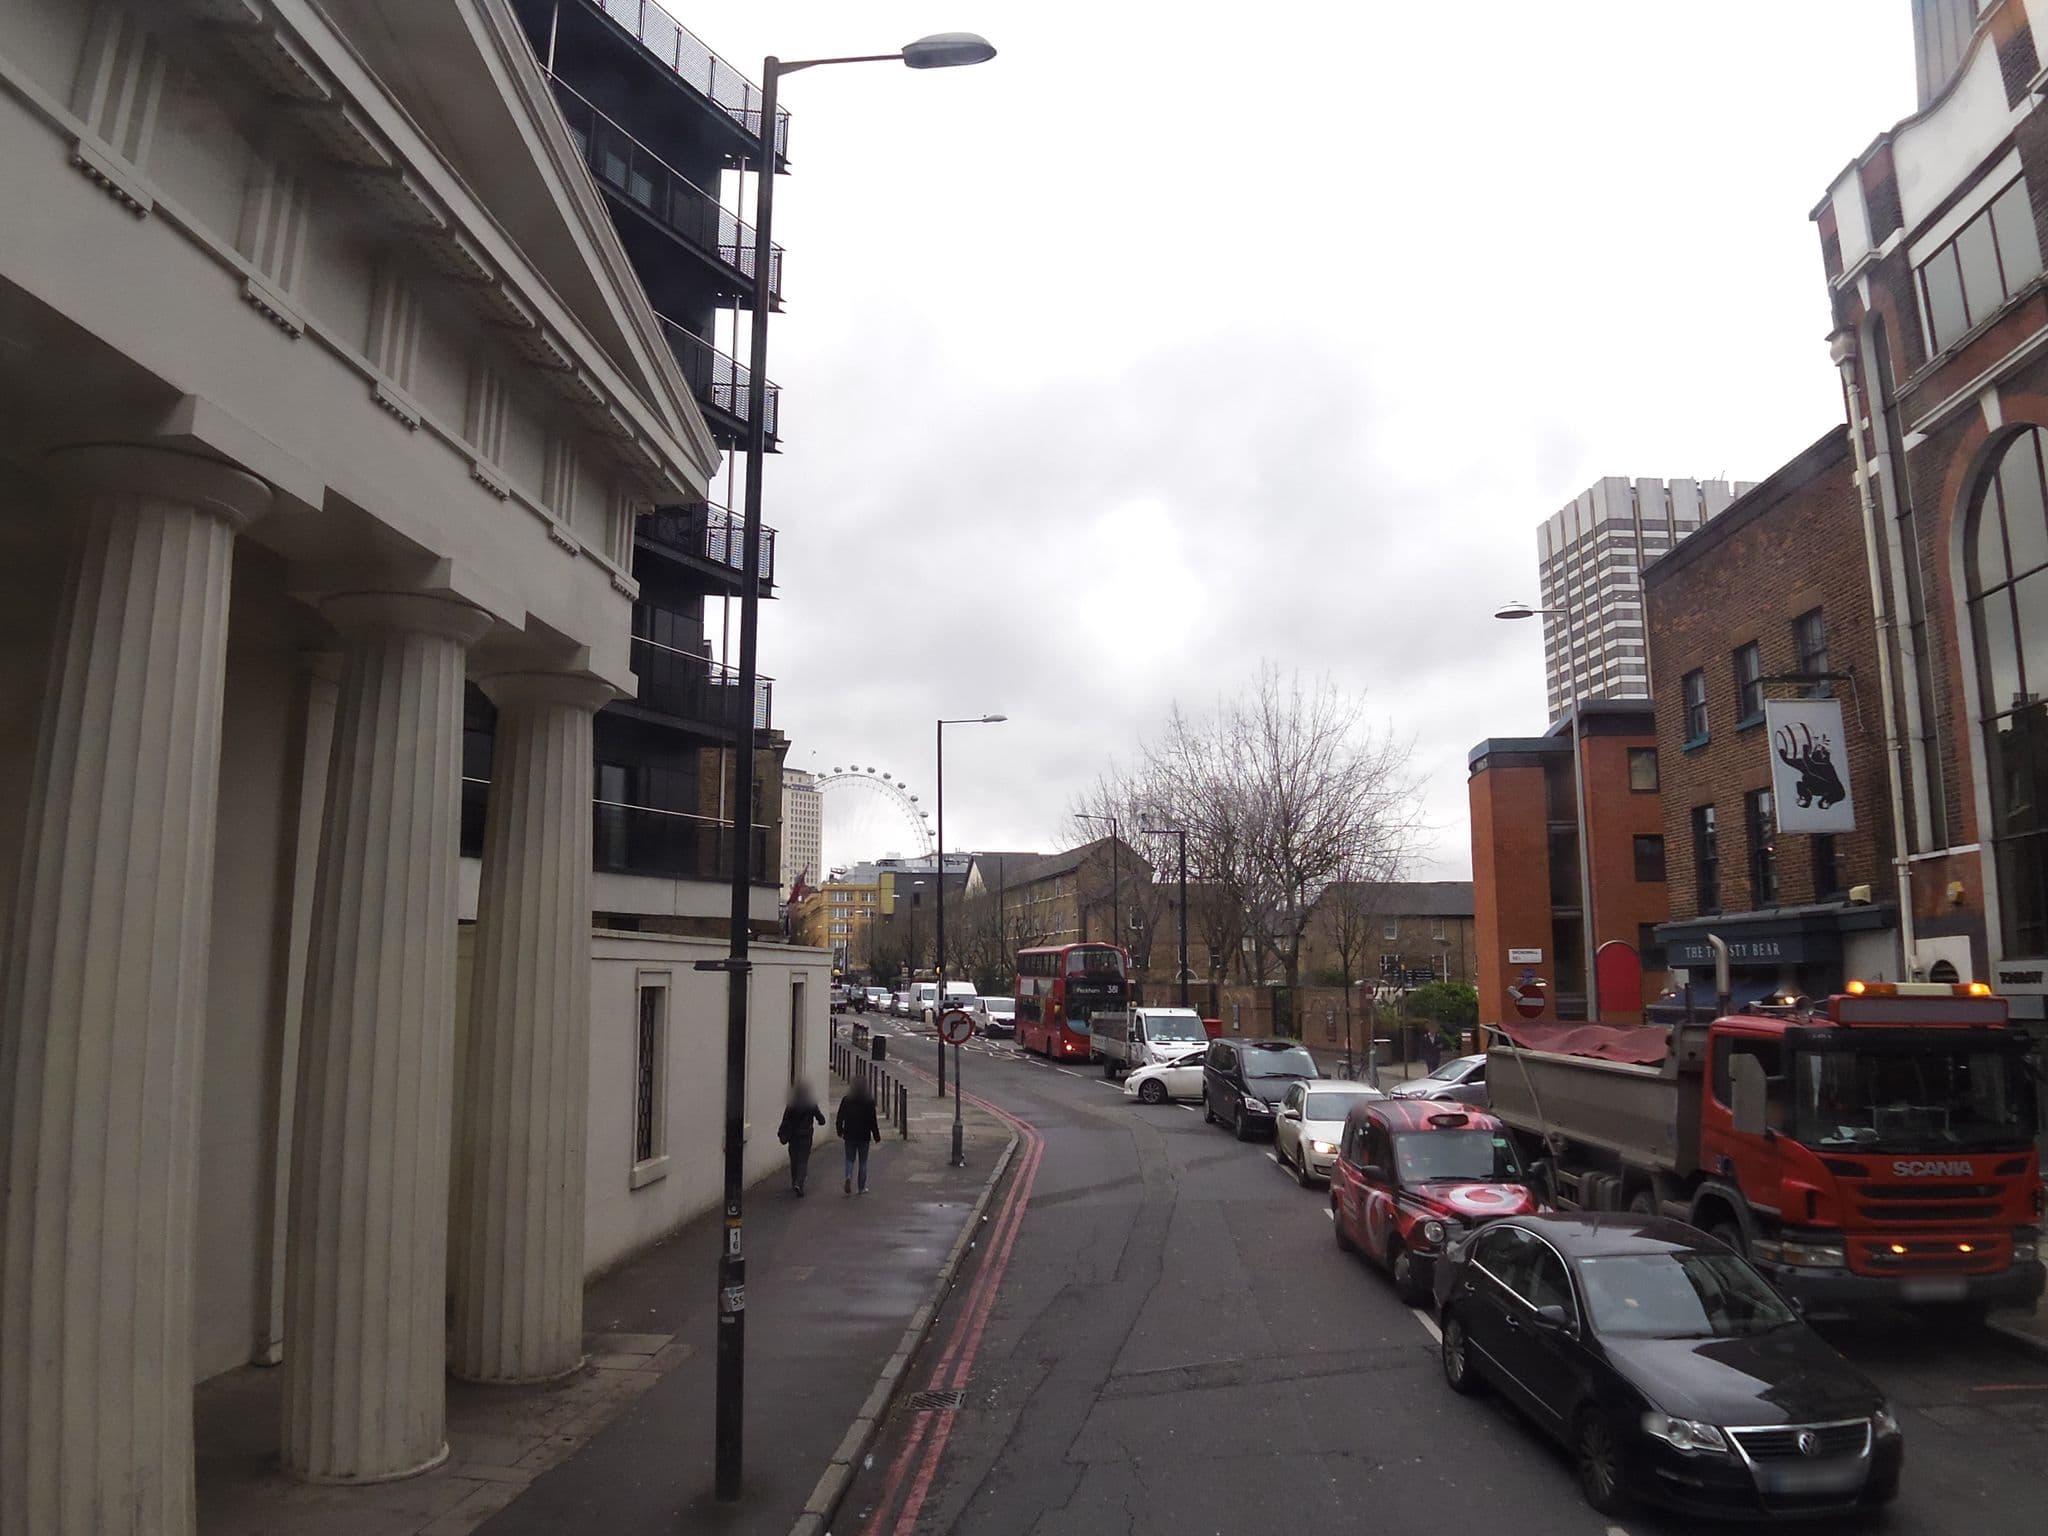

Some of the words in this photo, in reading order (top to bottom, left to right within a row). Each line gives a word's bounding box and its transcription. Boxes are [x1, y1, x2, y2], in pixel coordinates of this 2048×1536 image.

[1685, 946, 1703, 958] THE
[1753, 943, 1780, 956] BEAR
[1106, 985, 1119, 994] 381
[1893, 1161, 1973, 1176] SCANIA
